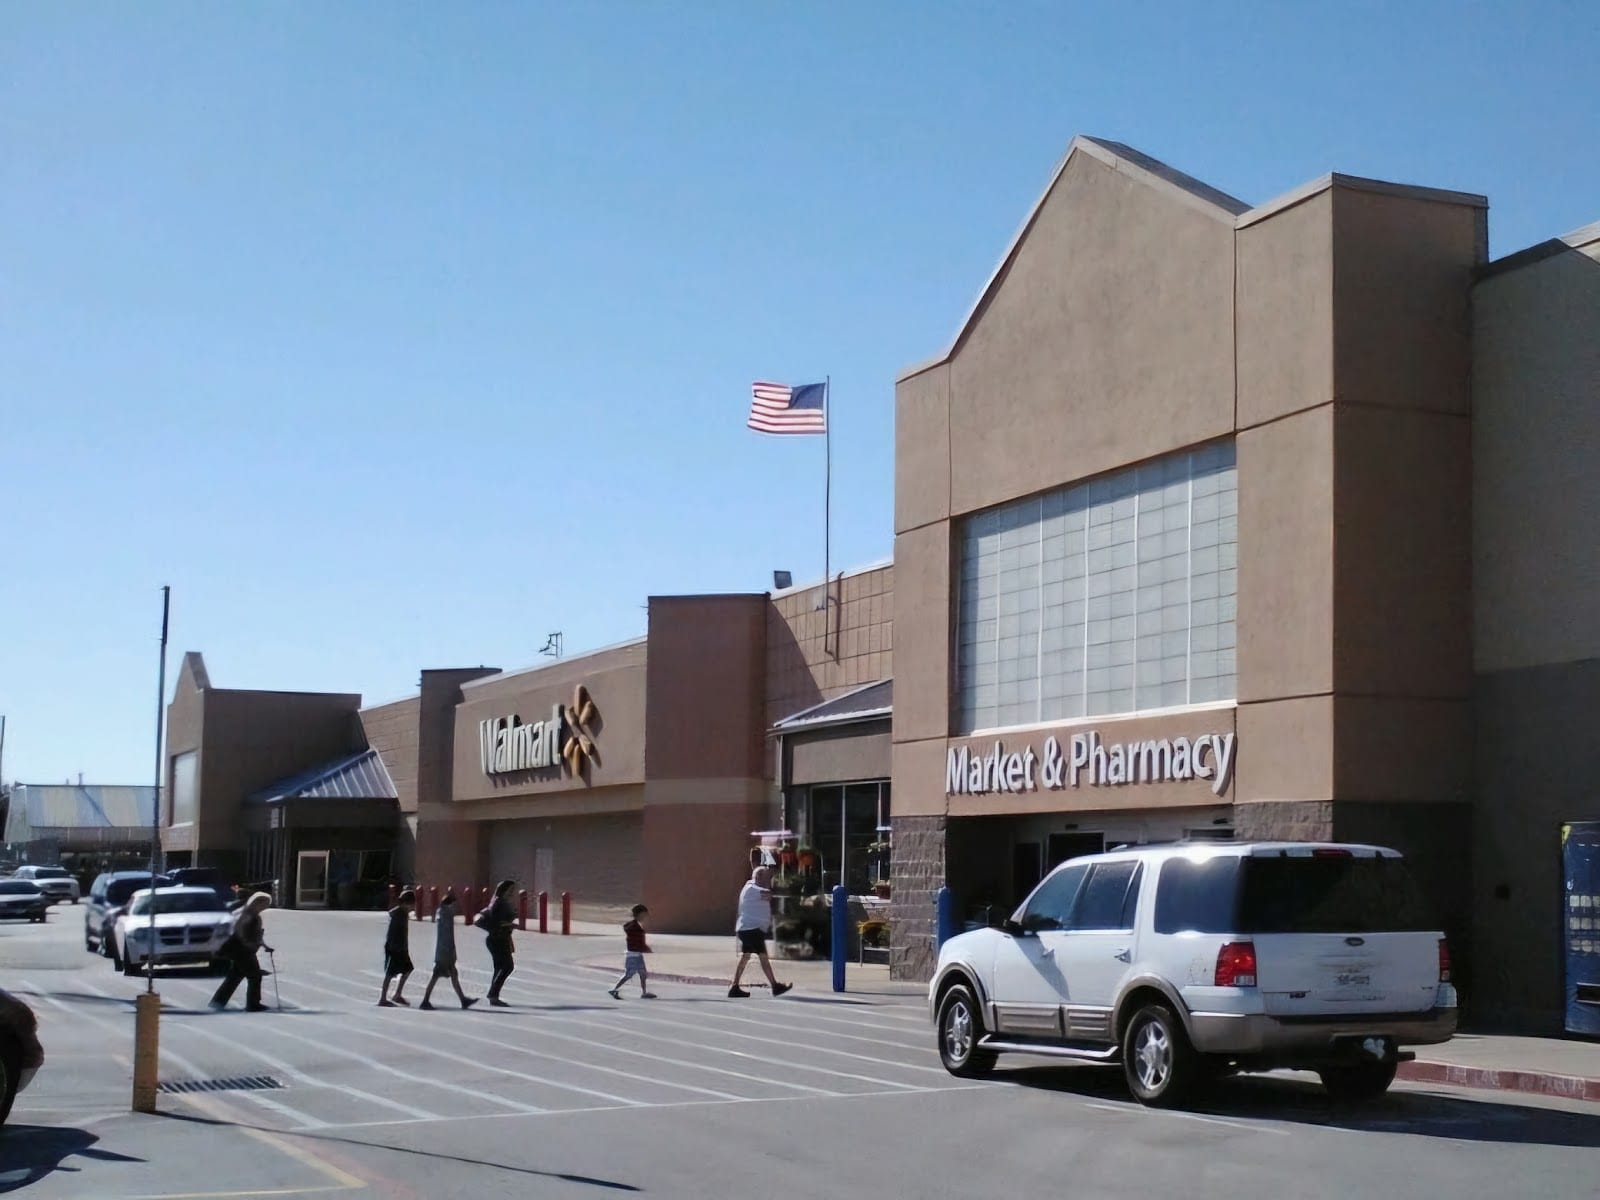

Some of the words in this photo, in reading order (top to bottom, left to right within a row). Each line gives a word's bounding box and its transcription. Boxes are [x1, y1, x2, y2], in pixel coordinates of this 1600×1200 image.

[480, 704, 561, 774] Walmart
[946, 740, 1034, 793] Market
[1041, 736, 1063, 787] &
[1070, 731, 1234, 796] Pharmacy
